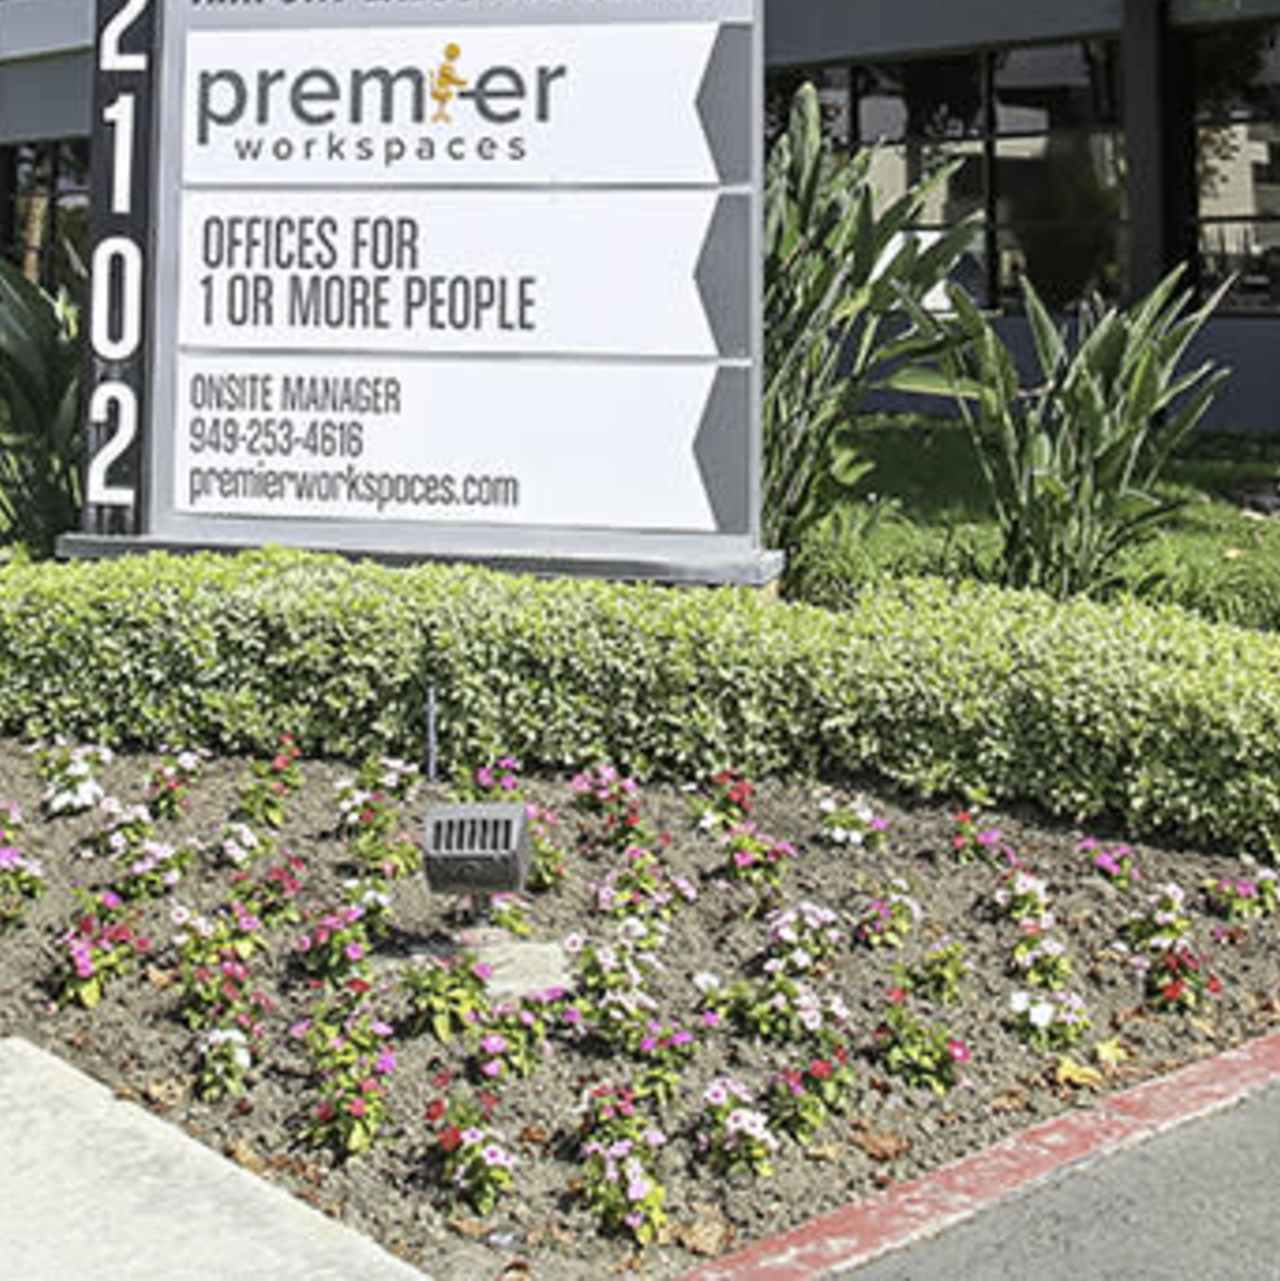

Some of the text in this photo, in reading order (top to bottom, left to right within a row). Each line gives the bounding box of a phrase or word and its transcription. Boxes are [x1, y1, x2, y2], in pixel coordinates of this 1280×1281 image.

[196, 42, 567, 144] premier
[234, 131, 527, 167] workspaces
[202, 215, 419, 271] OFFICES FOR
[200, 273, 536, 331] 1 OR MORE PEOPLE
[189, 373, 401, 415] ONSITE MANAGER
[189, 416, 364, 456] 949-253-4616
[189, 460, 520, 511] premierworkspaces.com
